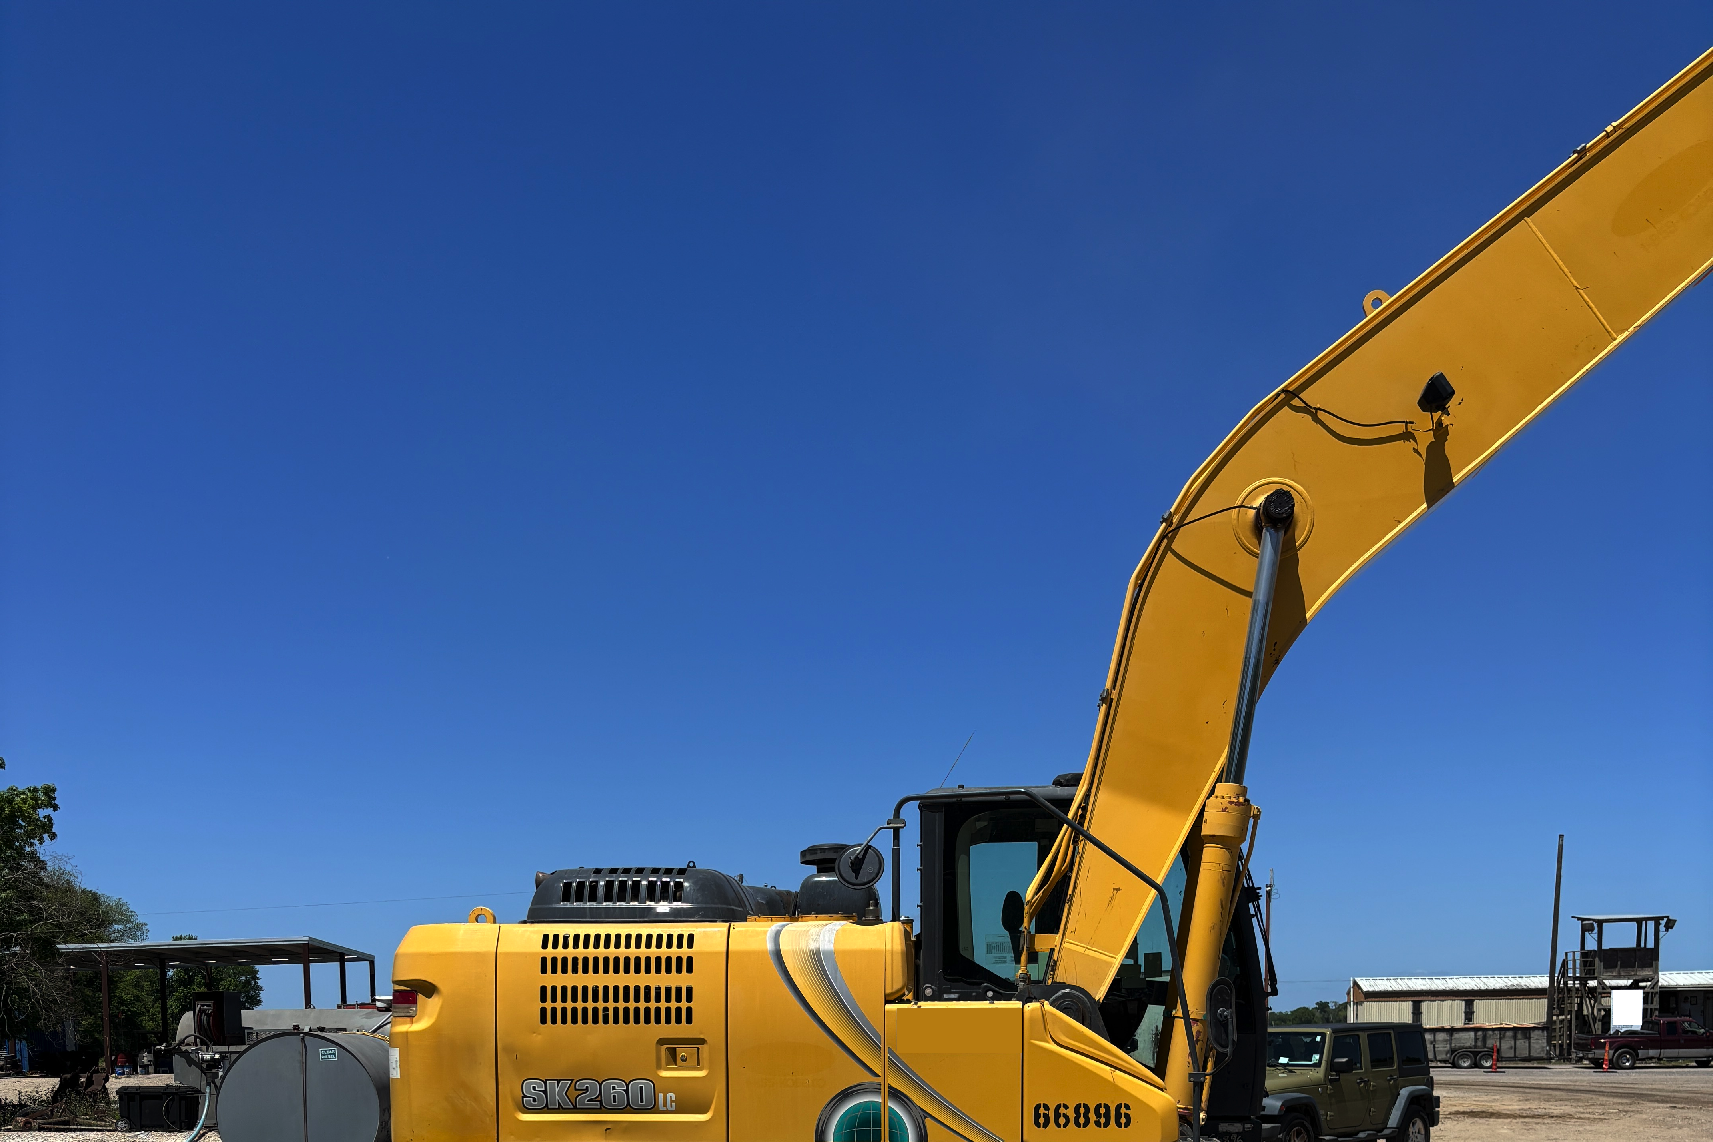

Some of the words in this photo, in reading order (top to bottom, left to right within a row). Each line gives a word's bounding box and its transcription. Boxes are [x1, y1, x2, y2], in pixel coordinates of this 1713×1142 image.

[521, 1078, 656, 1111] SK260
[658, 1093, 676, 1111] LC
[1033, 1102, 1132, 1129] 66896
